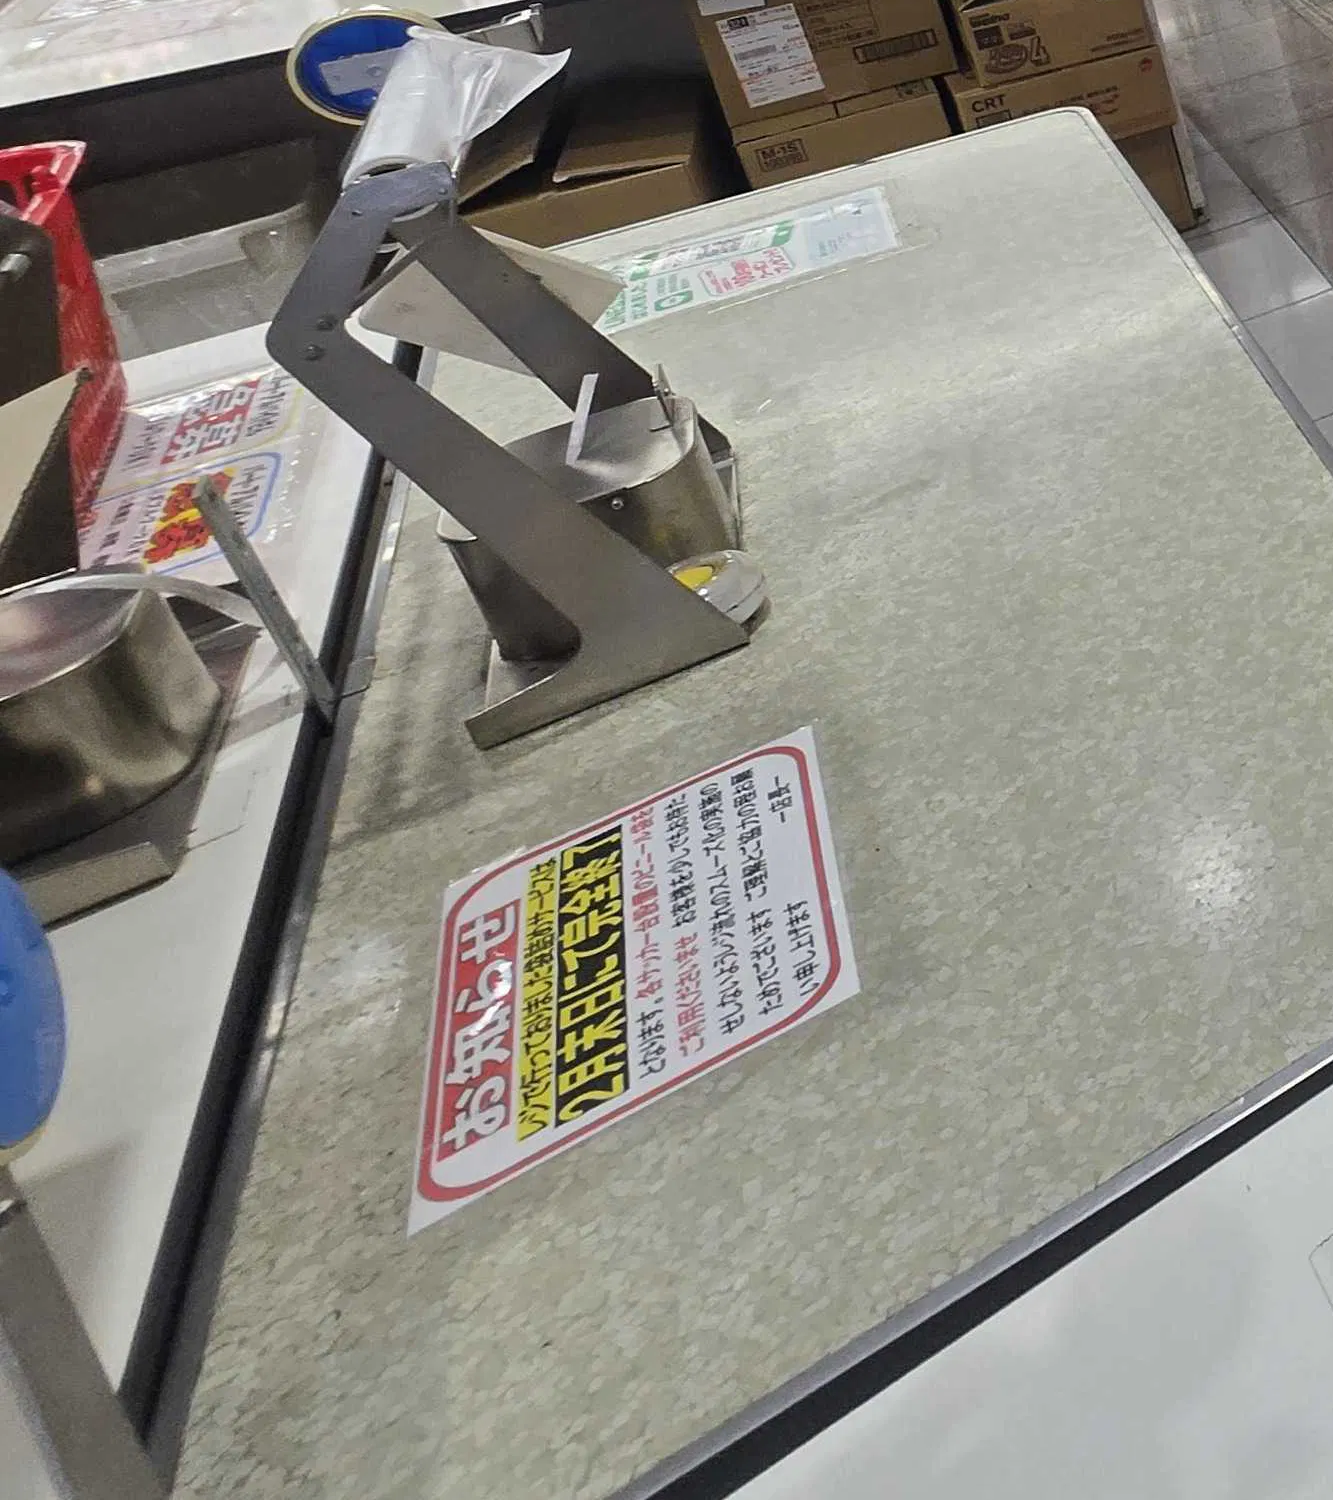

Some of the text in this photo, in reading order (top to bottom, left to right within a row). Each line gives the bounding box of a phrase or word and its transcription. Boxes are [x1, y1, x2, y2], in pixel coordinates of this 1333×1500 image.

[971, 94, 1006, 113] CRT
[516, 855, 557, 1144] レジで行っておりました袋詰めサービスは
[555, 824, 626, 1127] 2月末日にて完全終了
[664, 790, 709, 1061] ご利用くださいませ お客様を少しでもお待た
[697, 778, 747, 1039] せしないようレジ流れのスムーズ化の実施の
[730, 766, 785, 1019] ためでございます ご理解とご協力の程お願
[783, 892, 823, 1000] い申し上げます
[437, 898, 520, 1162] お知らせ
